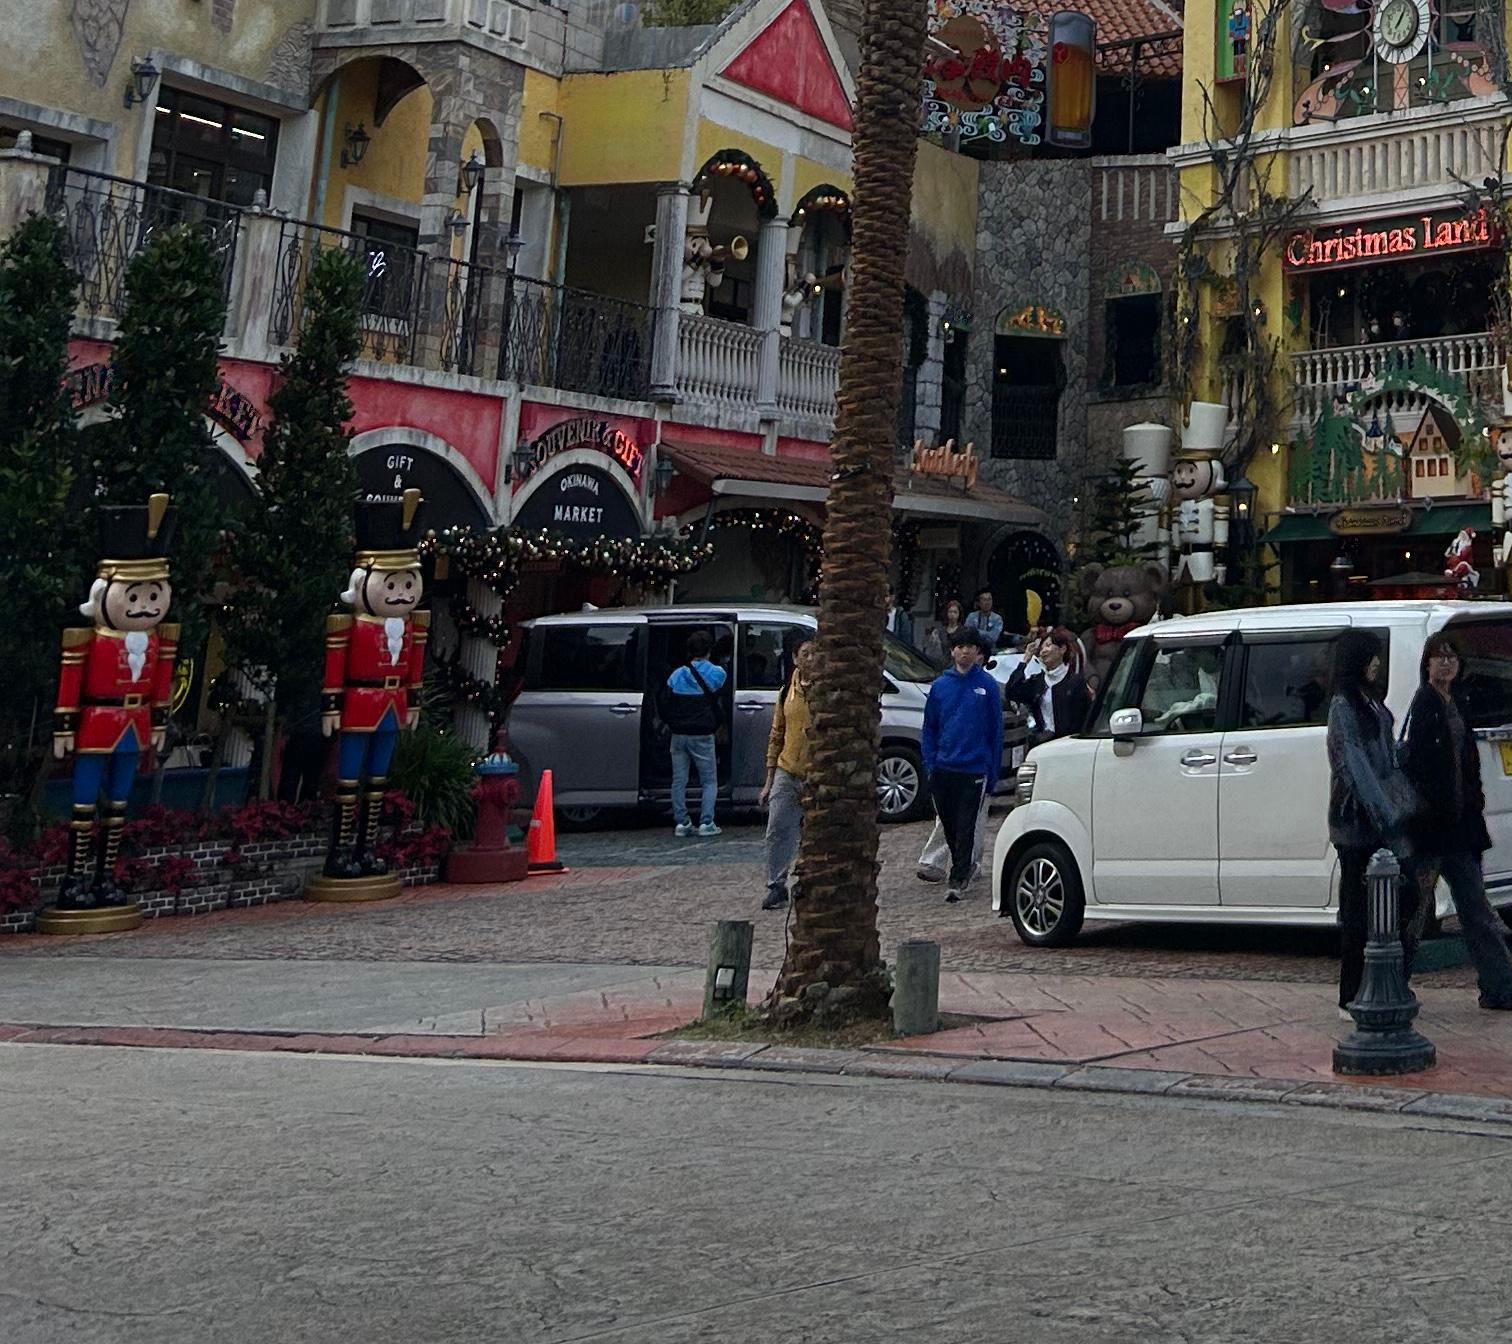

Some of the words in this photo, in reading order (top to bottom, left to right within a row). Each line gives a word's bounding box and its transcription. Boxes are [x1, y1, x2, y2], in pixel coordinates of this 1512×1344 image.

[1286, 227, 1417, 267] Christmas
[1420, 208, 1490, 249] Land
[386, 455, 414, 471] GIFT
[613, 429, 644, 479] GIFT
[393, 474, 403, 488] &
[560, 473, 600, 496] OKINAWA
[554, 505, 604, 524] MARKET
